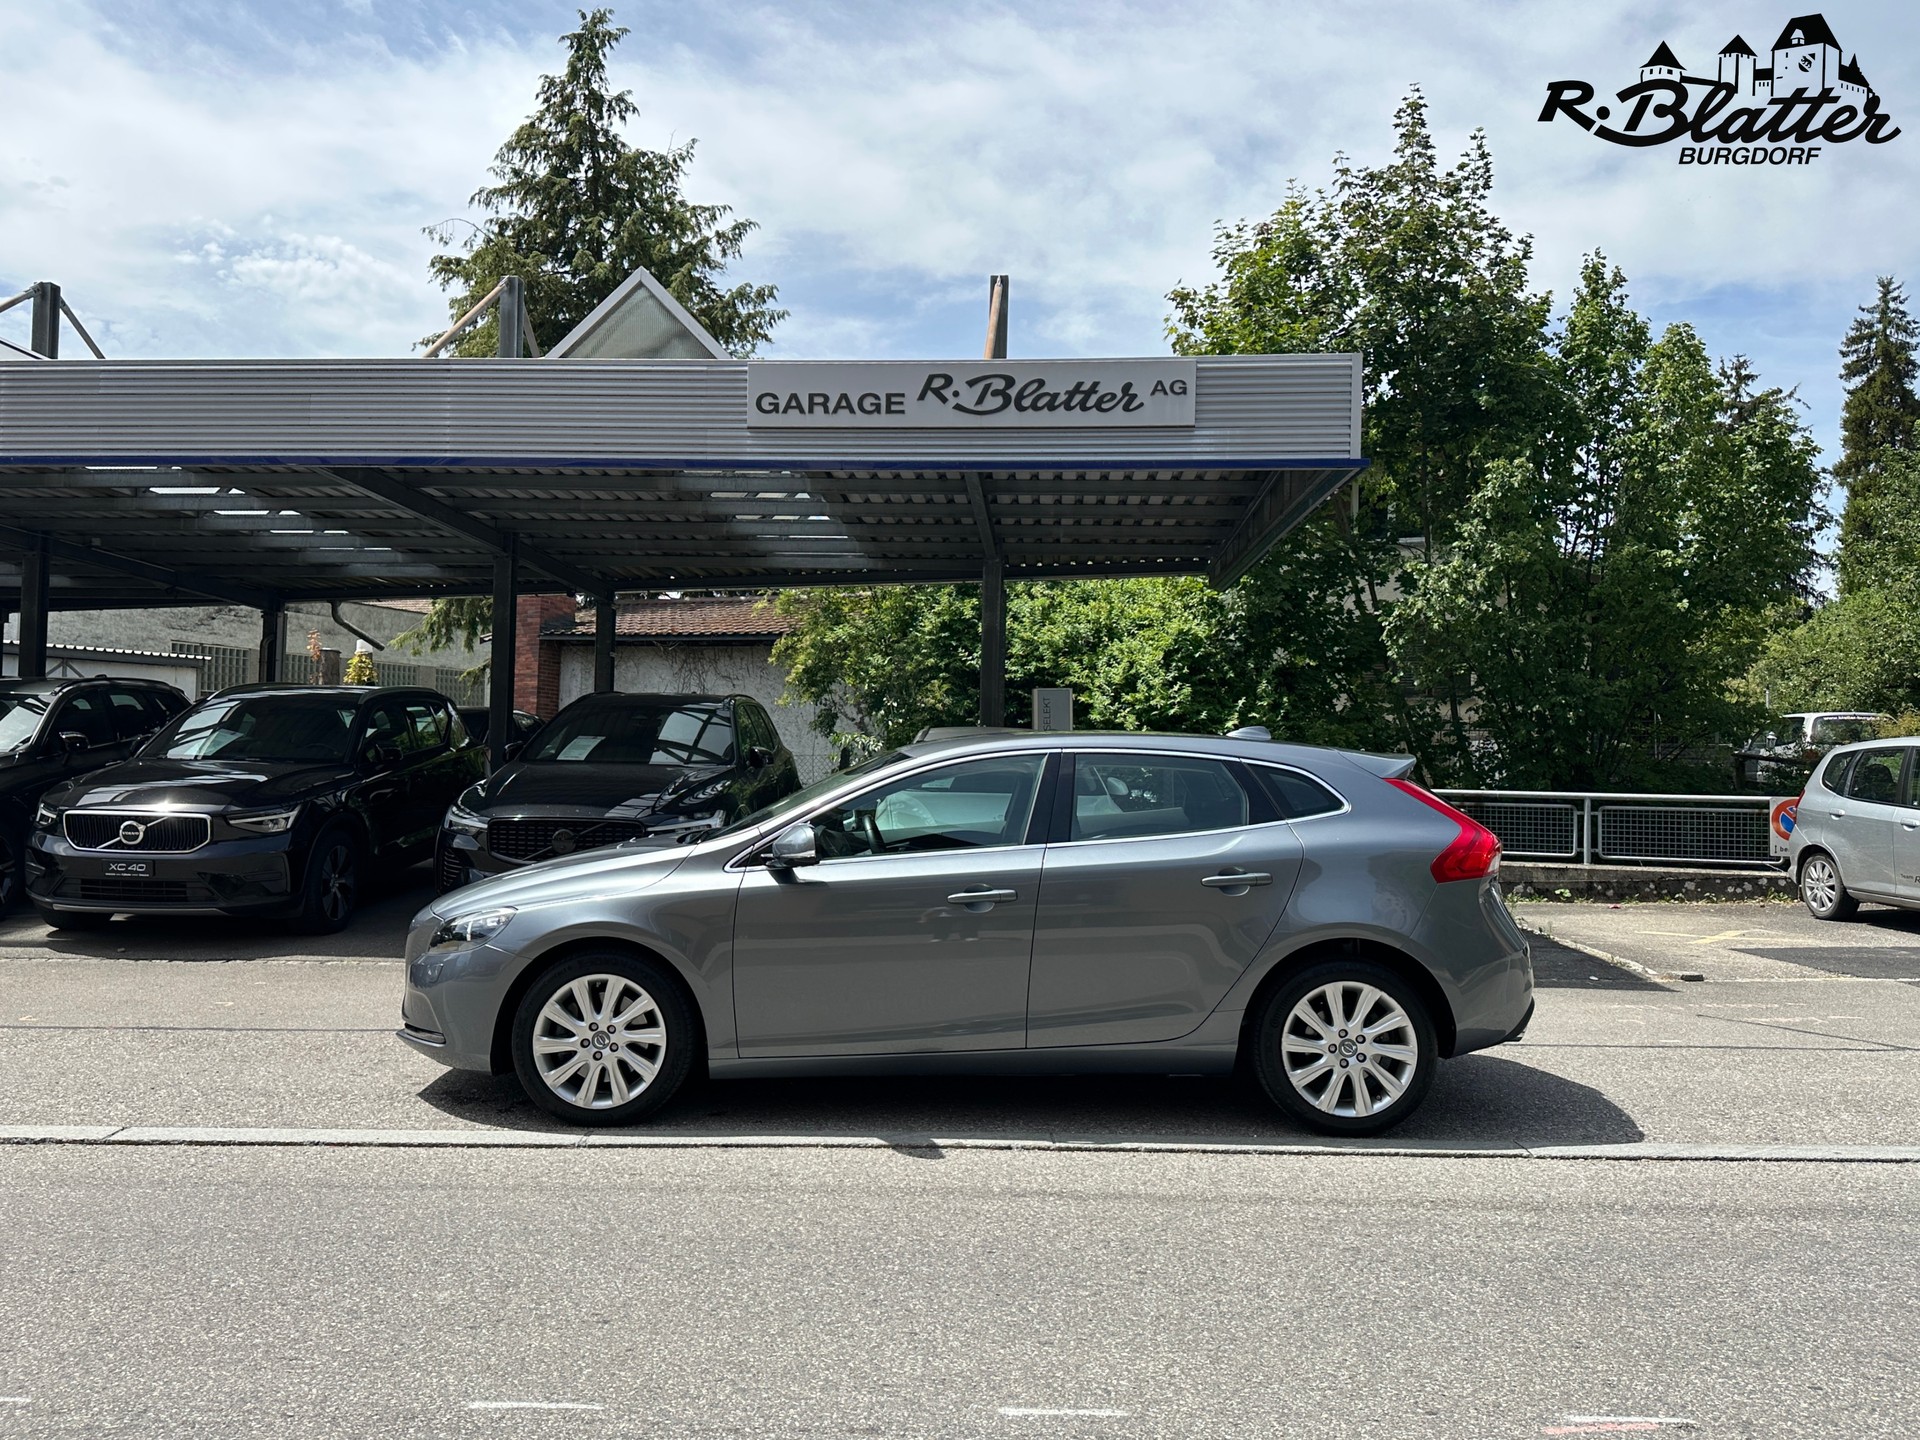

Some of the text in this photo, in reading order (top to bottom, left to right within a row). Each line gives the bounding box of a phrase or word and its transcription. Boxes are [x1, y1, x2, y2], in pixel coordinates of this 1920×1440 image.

[755, 392, 906, 415] GARAGE
[1150, 379, 1188, 396] AG
[1042, 696, 1051, 731] SELEKT
[109, 863, 146, 873] XC 40
